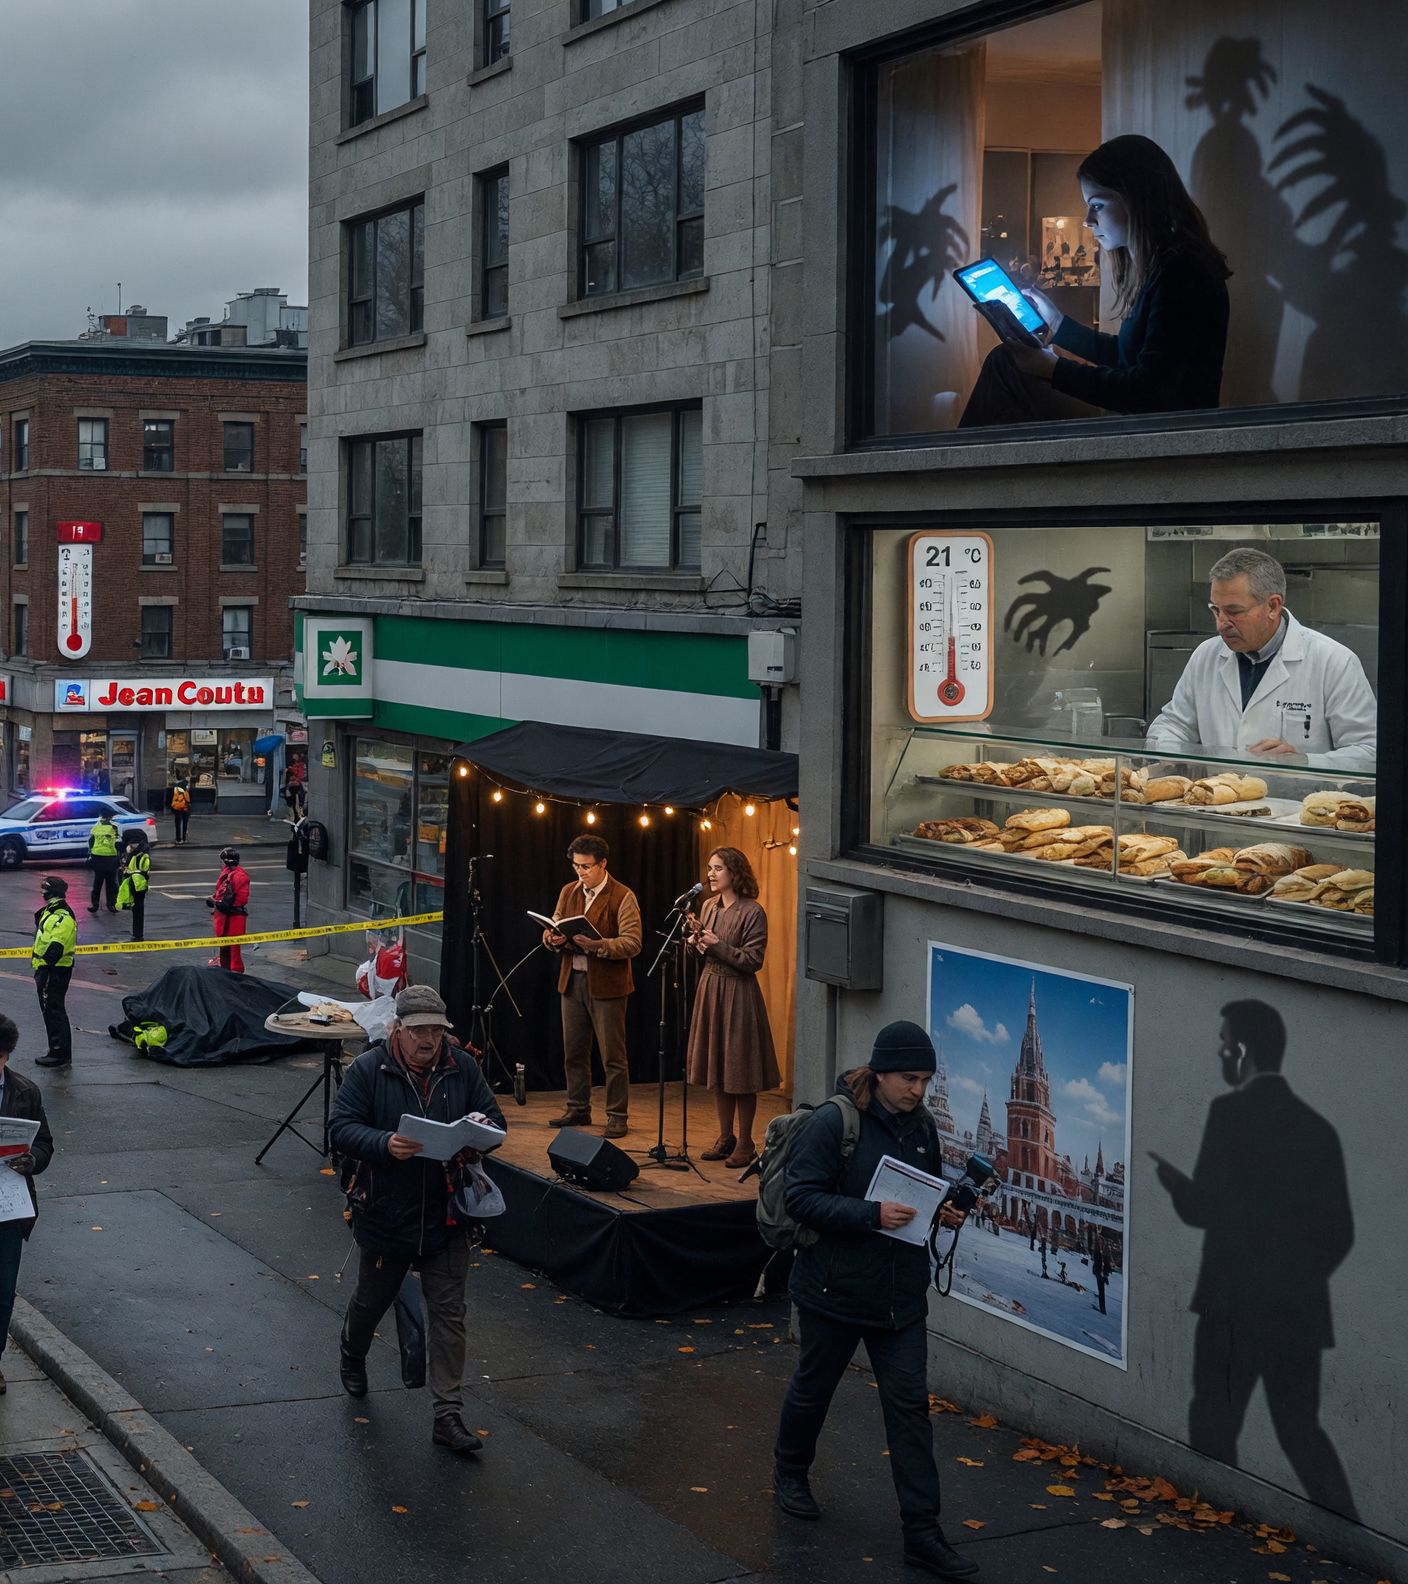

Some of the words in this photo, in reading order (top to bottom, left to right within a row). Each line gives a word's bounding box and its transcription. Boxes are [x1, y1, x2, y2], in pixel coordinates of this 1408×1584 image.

[925, 545, 951, 568] 21
[964, 547, 982, 564] °C
[98, 682, 173, 706] Jean
[177, 680, 265, 706] Coutu
